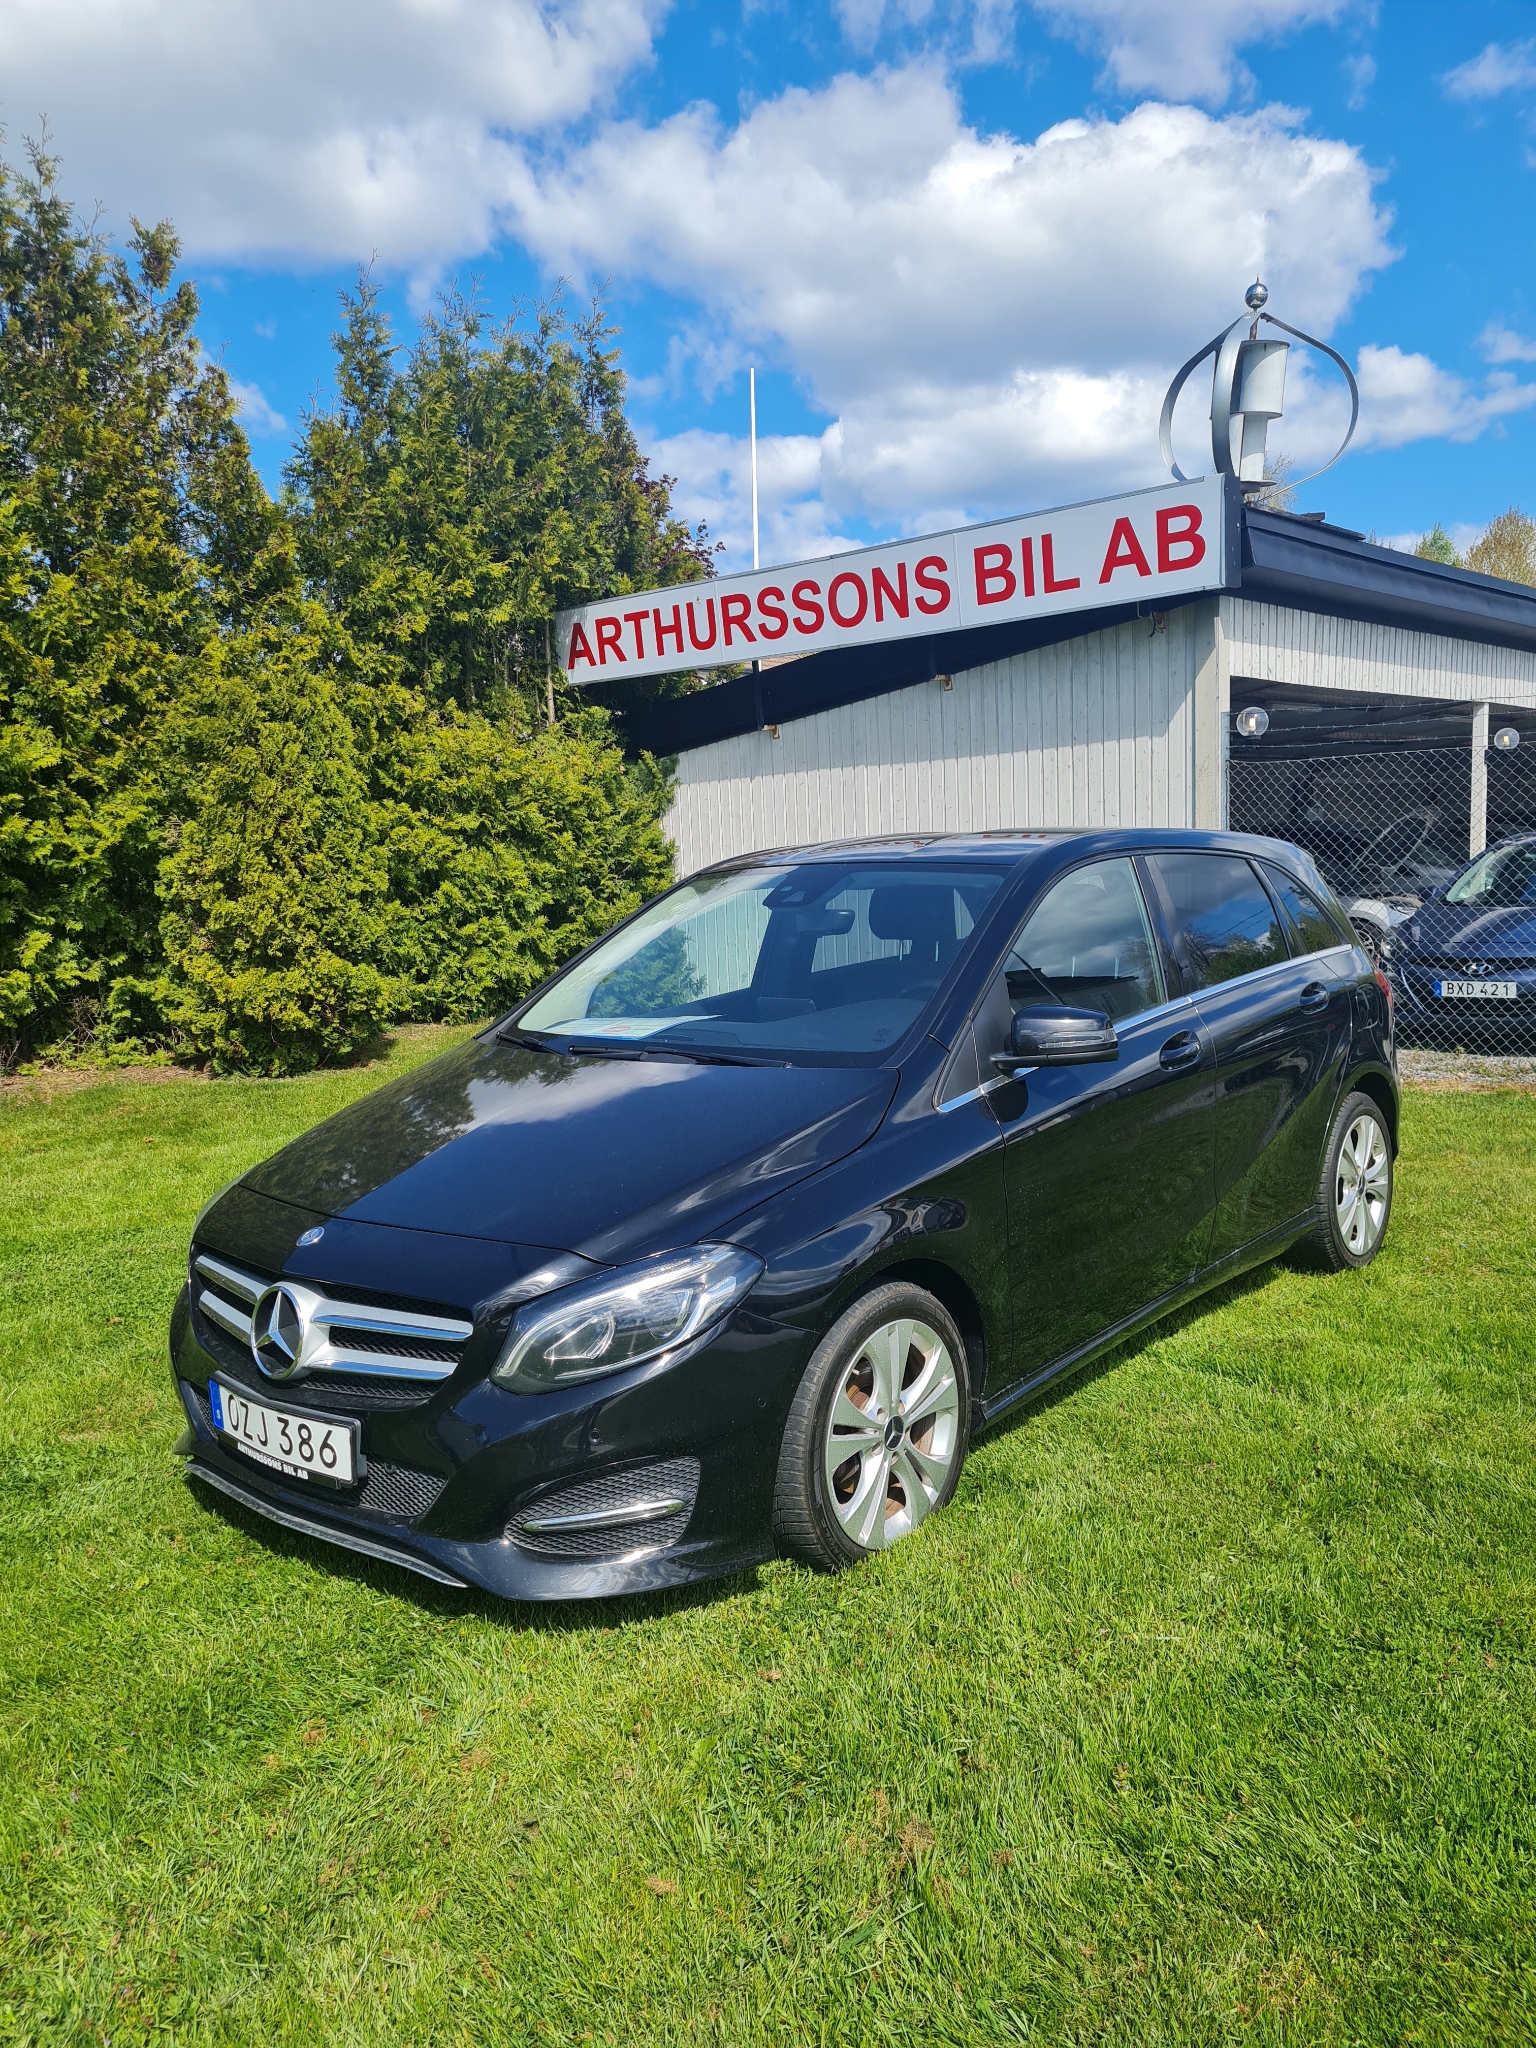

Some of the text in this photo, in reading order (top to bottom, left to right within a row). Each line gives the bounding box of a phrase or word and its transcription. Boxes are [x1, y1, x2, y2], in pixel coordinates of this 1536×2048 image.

[568, 504, 1207, 670] ARTHURSSONS BIL AB
[1446, 982, 1510, 997] BXD 421
[227, 1394, 338, 1469] OZJ 386
[283, 1463, 296, 1477] BIL
[297, 1468, 309, 1480] AB
